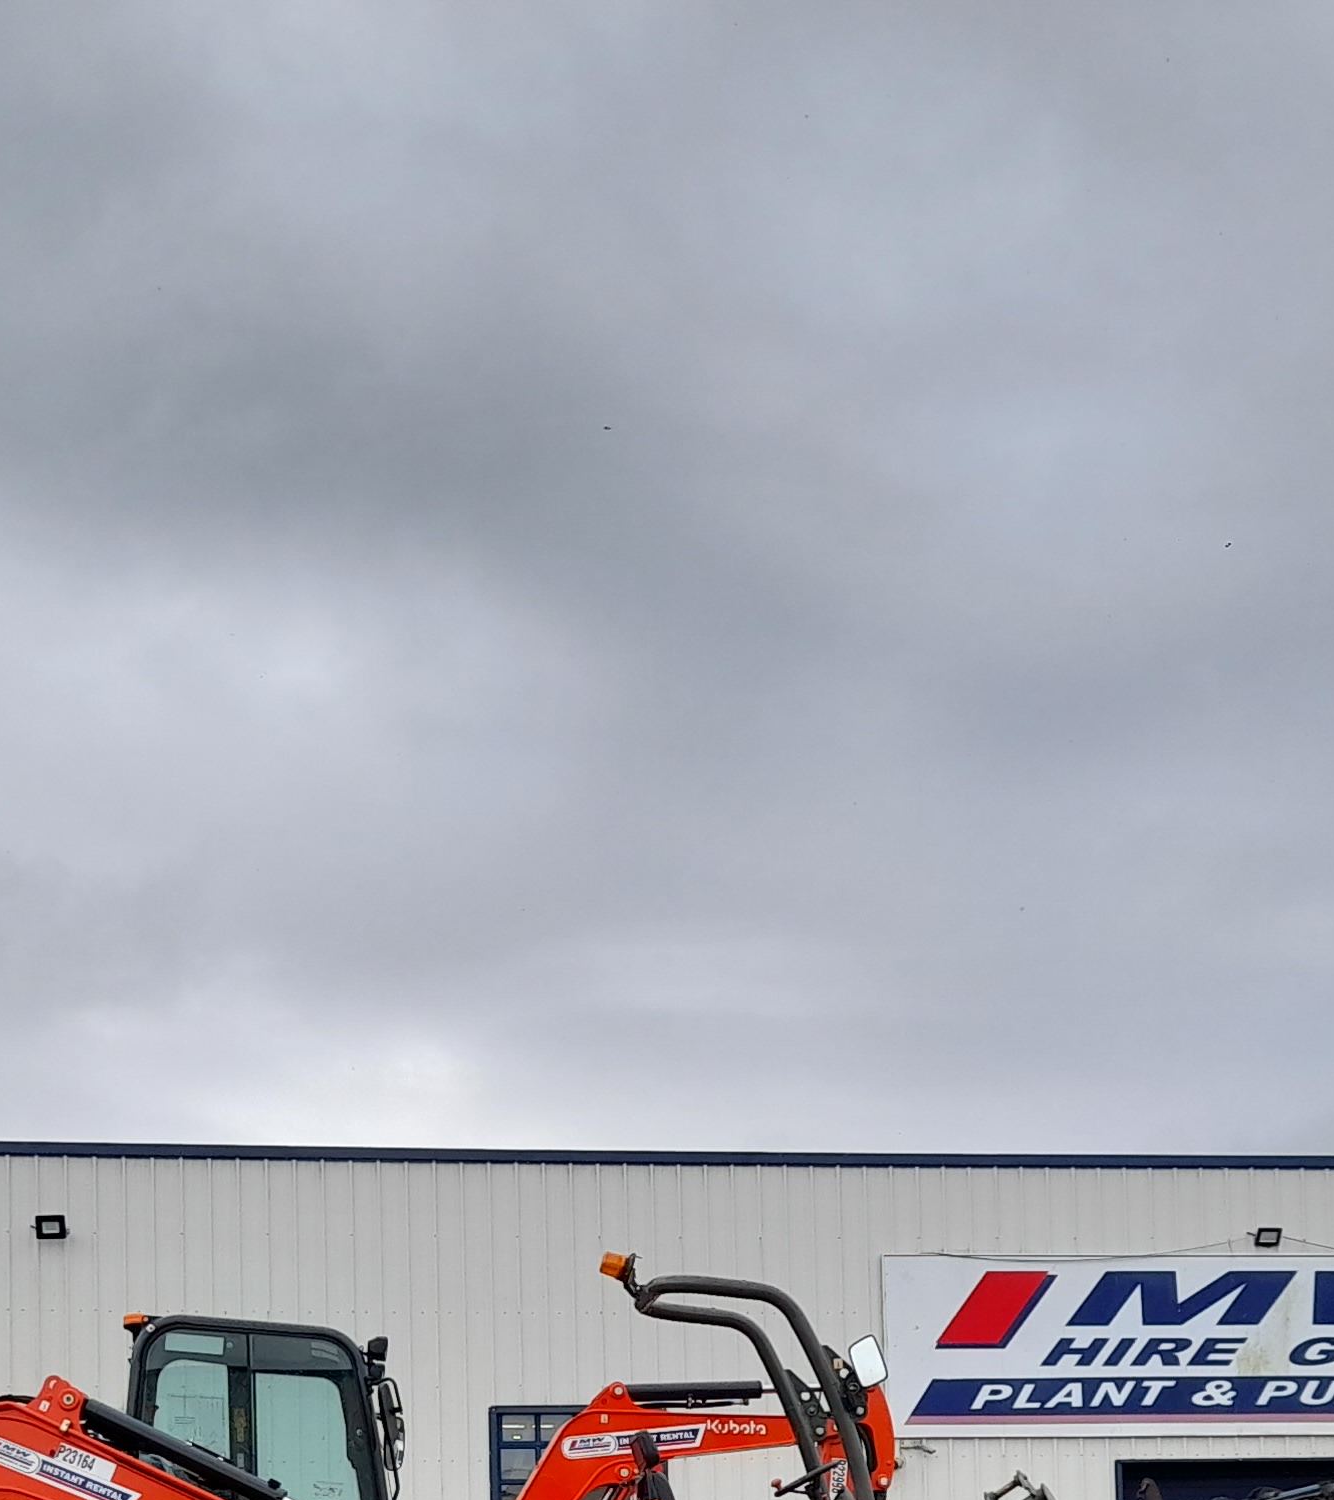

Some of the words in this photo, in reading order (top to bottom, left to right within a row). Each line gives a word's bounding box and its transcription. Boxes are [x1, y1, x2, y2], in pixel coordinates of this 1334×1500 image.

[1040, 1336, 1247, 1367] HIRE
[969, 1380, 1176, 1411] PLANT
[1190, 1380, 1238, 1408] &
[660, 1431, 695, 1441] RENTAL
[707, 1419, 767, 1435] Kubota
[56, 1445, 96, 1471] P23164
[42, 1464, 85, 1486] INSTANT
